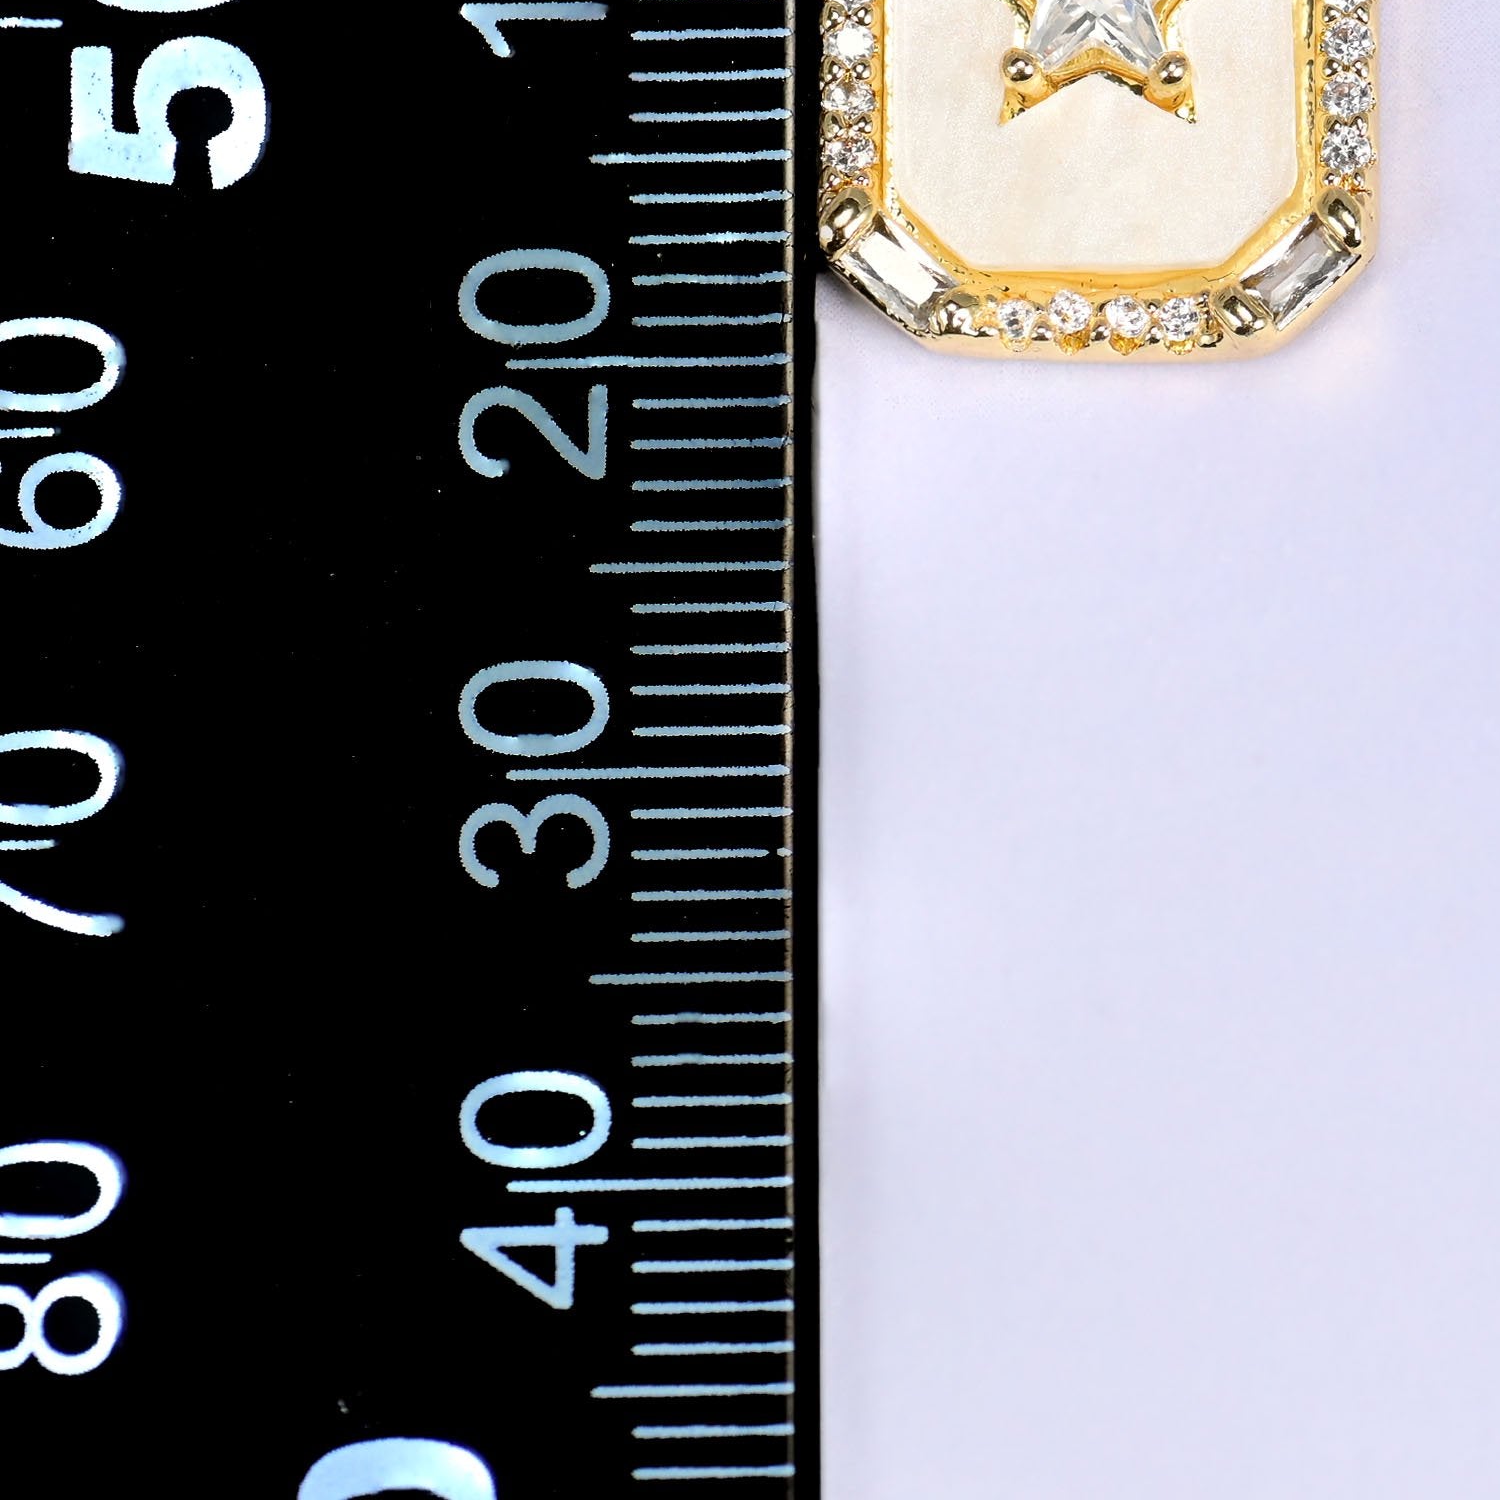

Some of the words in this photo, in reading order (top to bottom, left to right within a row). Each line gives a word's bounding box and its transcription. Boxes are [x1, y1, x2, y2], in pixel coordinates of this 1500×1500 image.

[0, 316, 126, 551] 60
[457, 247, 611, 481] 20
[457, 659, 611, 890] 30
[0, 1140, 126, 1377] 80
[458, 1070, 613, 1311] 40
